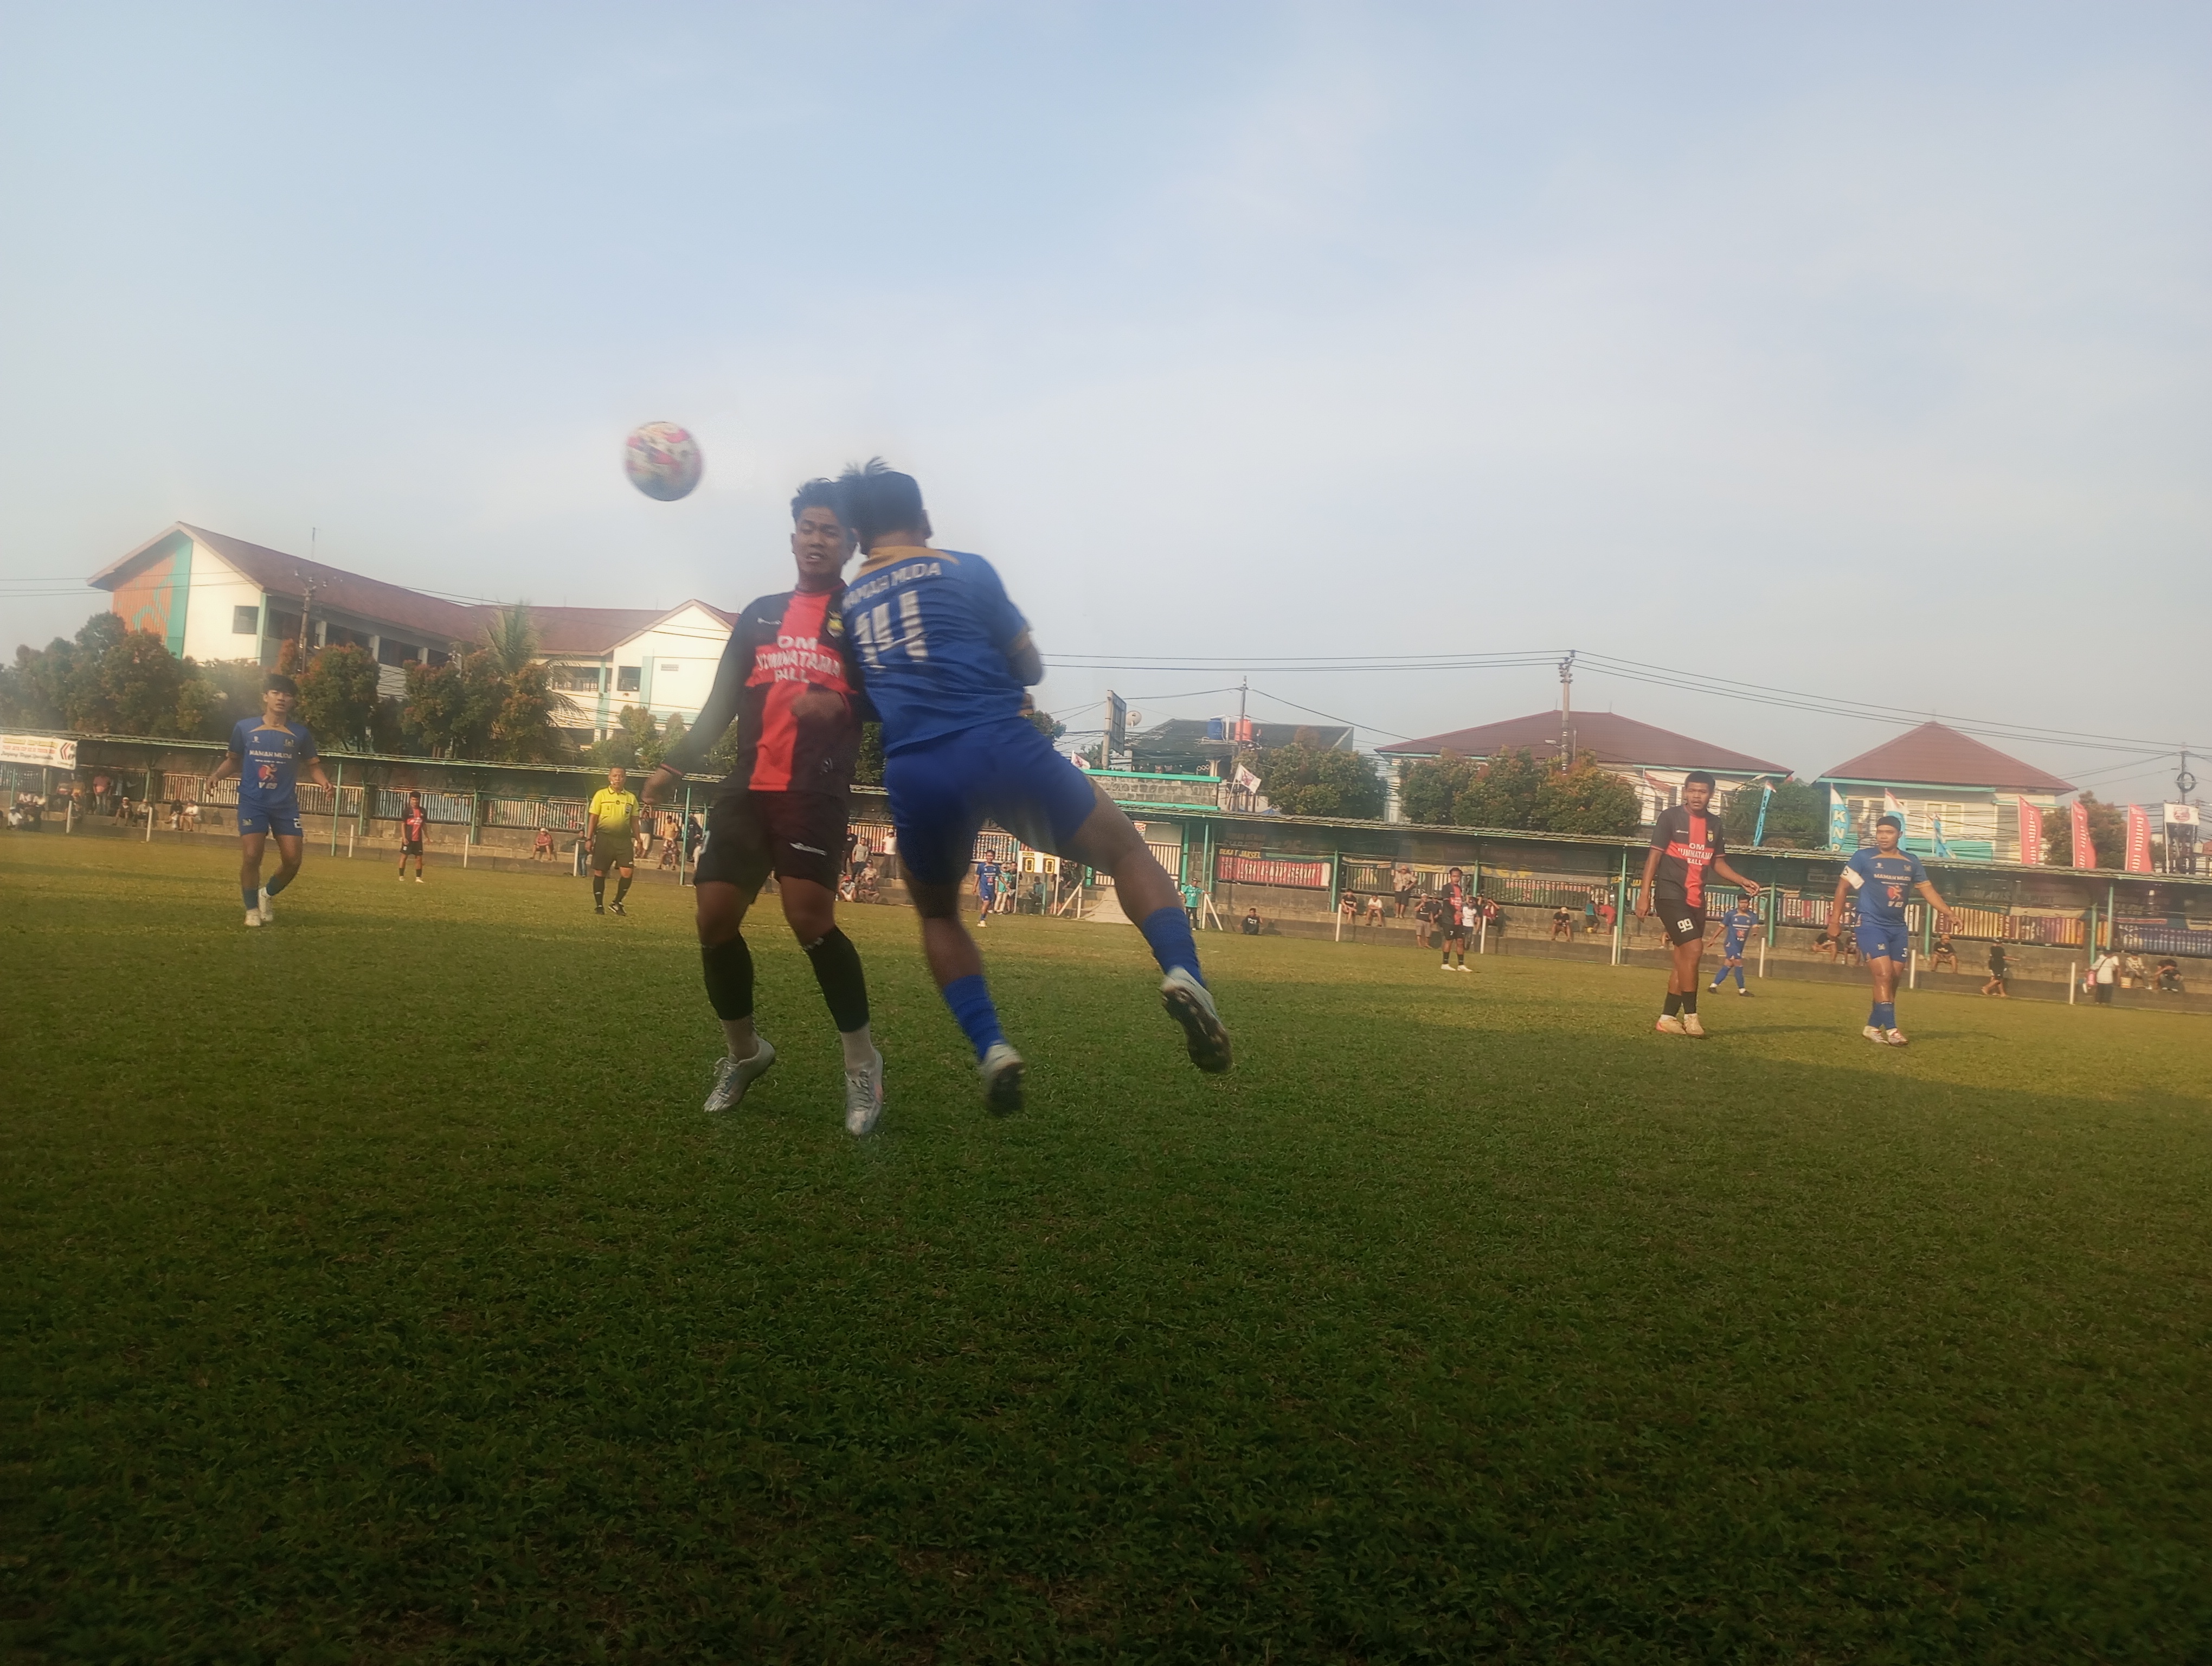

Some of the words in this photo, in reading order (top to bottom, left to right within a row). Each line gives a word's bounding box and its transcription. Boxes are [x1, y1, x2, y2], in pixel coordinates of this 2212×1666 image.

[854, 590, 929, 668] 14
[777, 635, 818, 651] OM
[1677, 918, 1694, 933] 99
